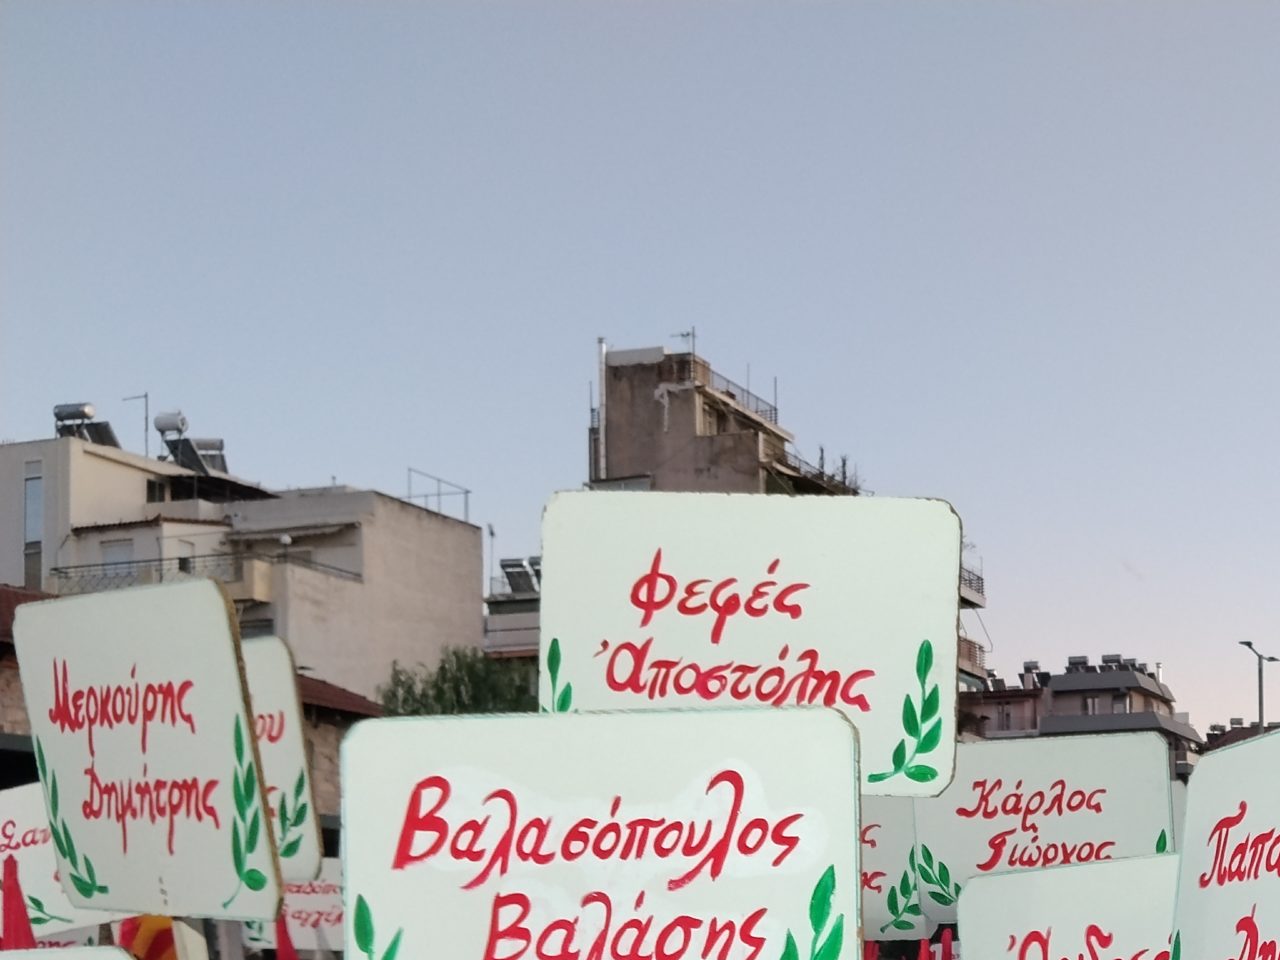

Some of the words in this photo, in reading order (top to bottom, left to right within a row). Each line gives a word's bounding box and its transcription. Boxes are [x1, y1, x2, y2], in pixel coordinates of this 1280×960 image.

[630, 547, 809, 644] Φεφές
[49, 657, 195, 754] Μερκούρης
[82, 760, 220, 854] Δημήτρης
[392, 770, 805, 892] Βαλασόπουλος
[956, 778, 1106, 833] Κάρλος
